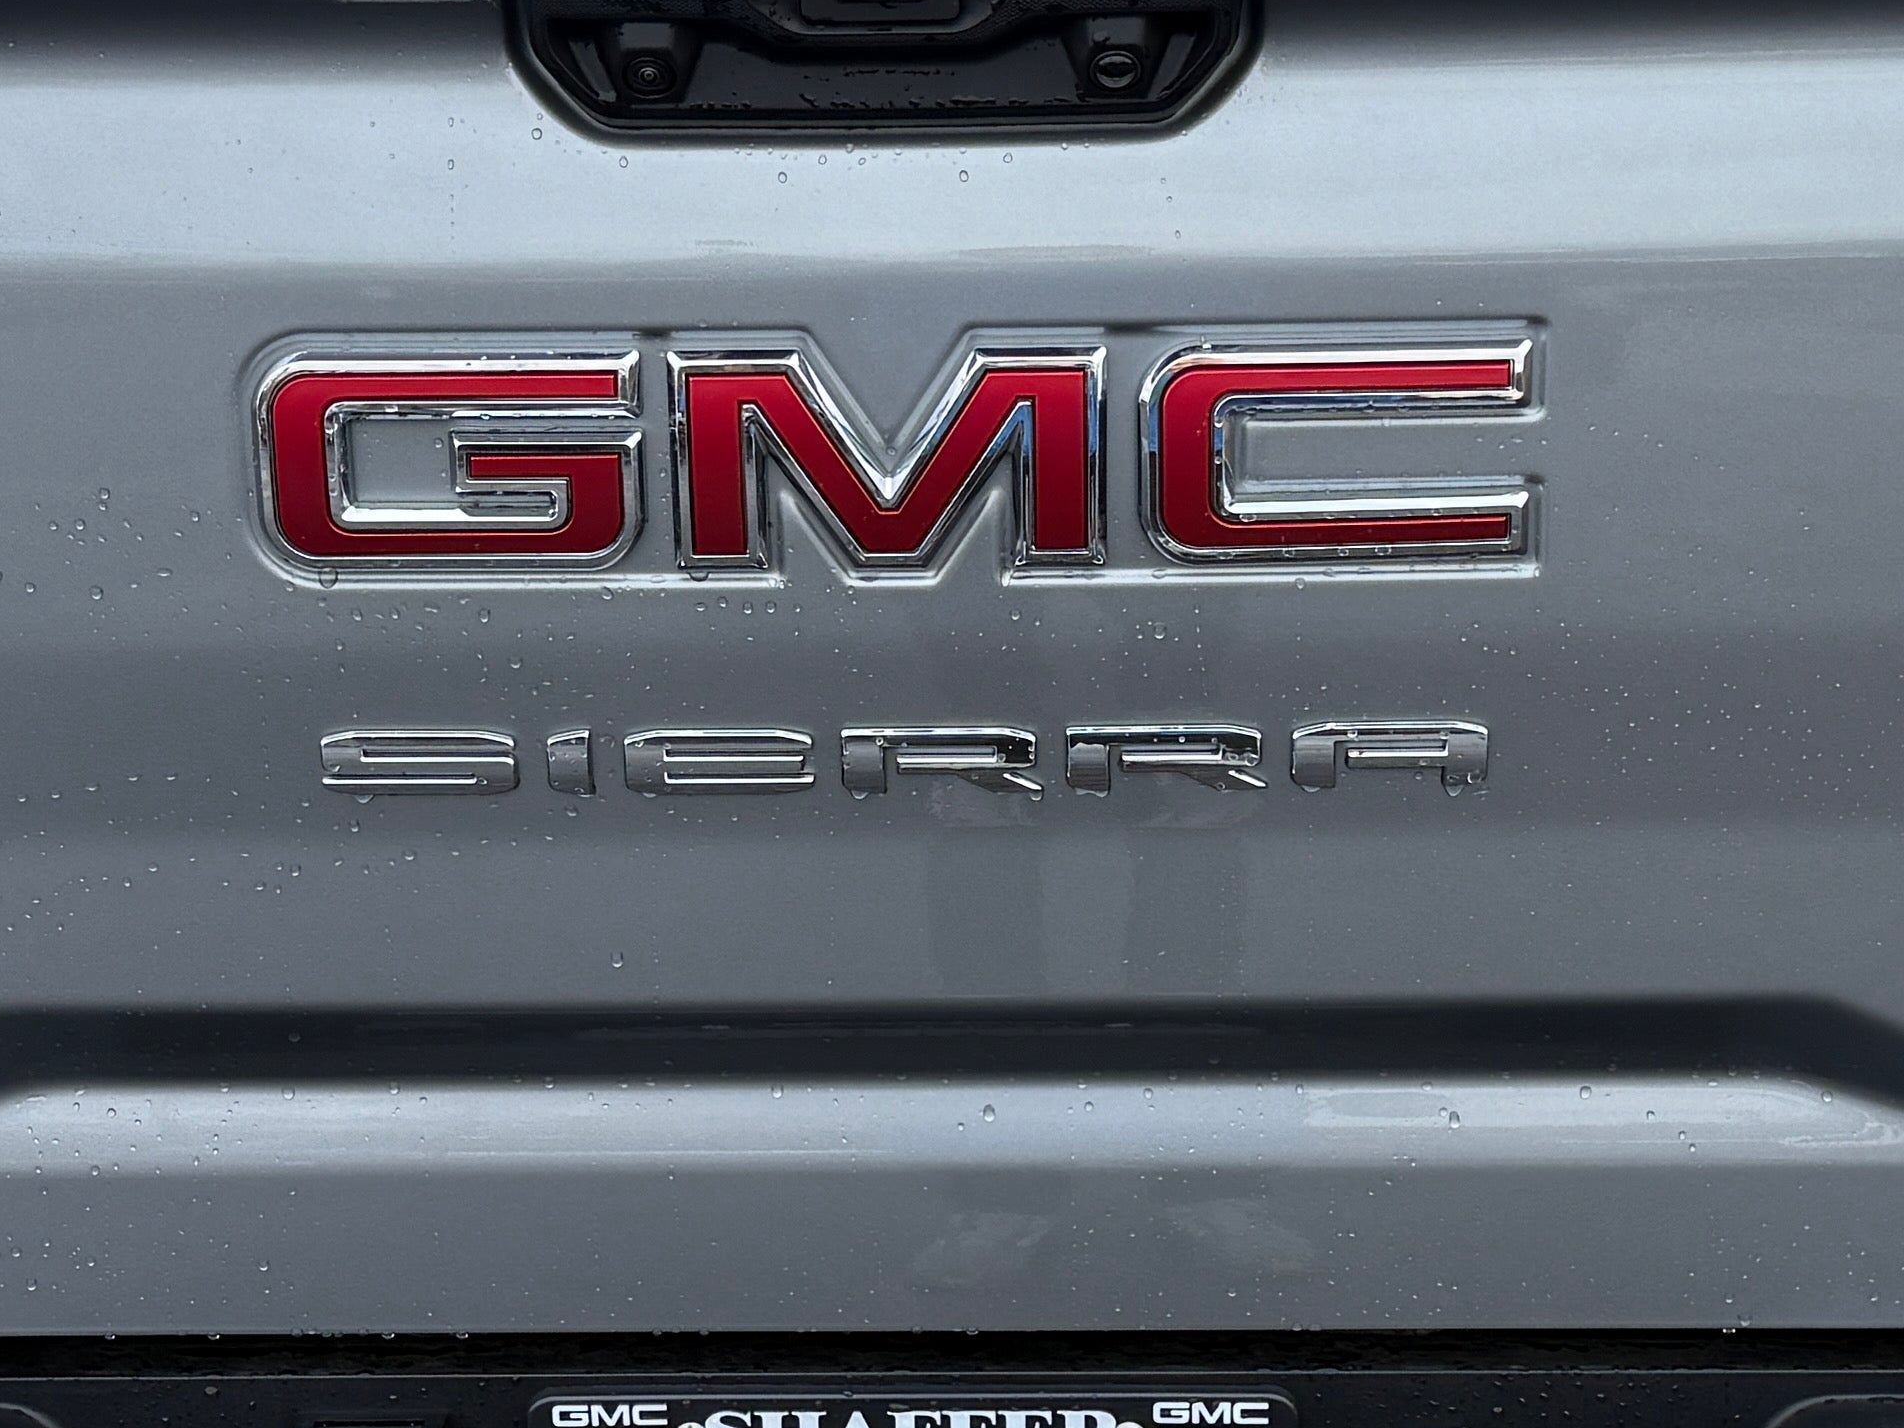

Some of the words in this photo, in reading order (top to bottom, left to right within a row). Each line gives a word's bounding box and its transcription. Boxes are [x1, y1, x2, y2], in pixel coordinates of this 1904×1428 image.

[261, 338, 1534, 569] GMC
[318, 719, 1491, 802] SIERRA
[551, 1403, 668, 1428] GMC
[1152, 1402, 1270, 1425] GMC
